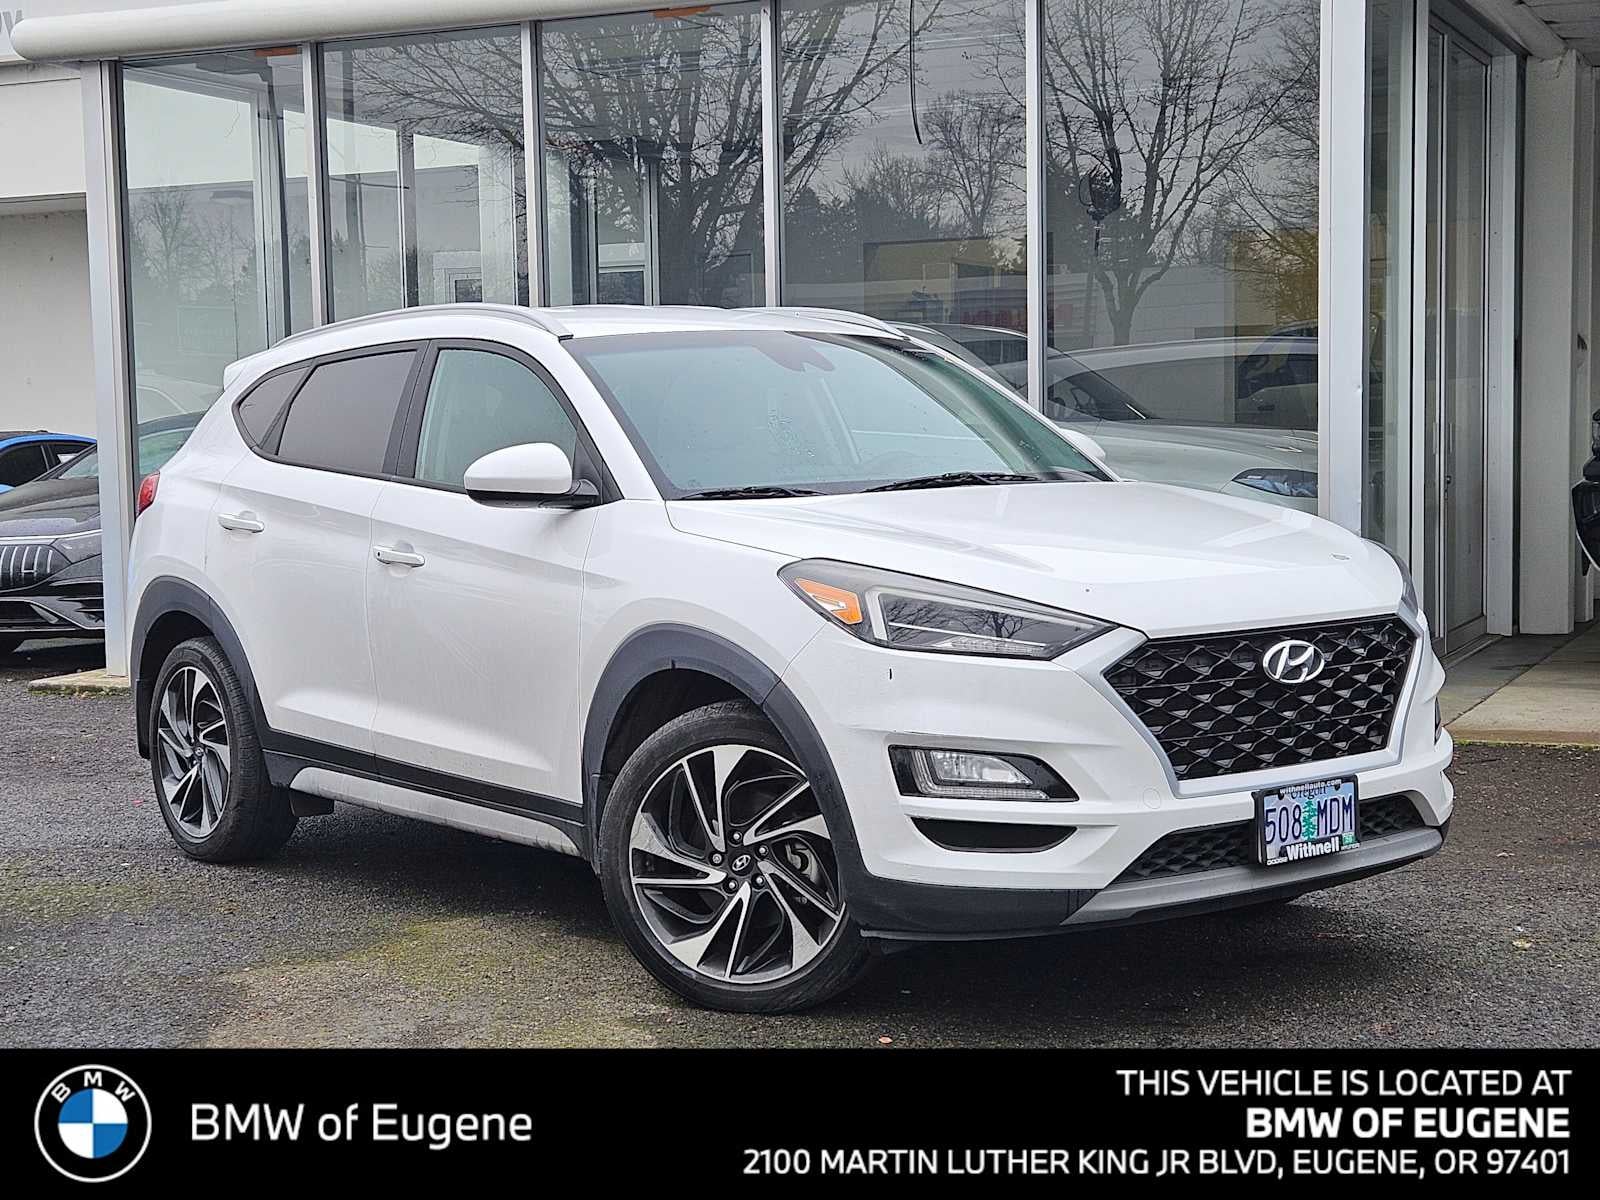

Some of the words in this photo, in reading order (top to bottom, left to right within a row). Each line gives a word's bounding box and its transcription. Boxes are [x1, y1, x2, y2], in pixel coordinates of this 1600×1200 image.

[1264, 804, 1302, 845] 508
[1316, 794, 1354, 837] MDM
[1286, 836, 1340, 861] Withnell
